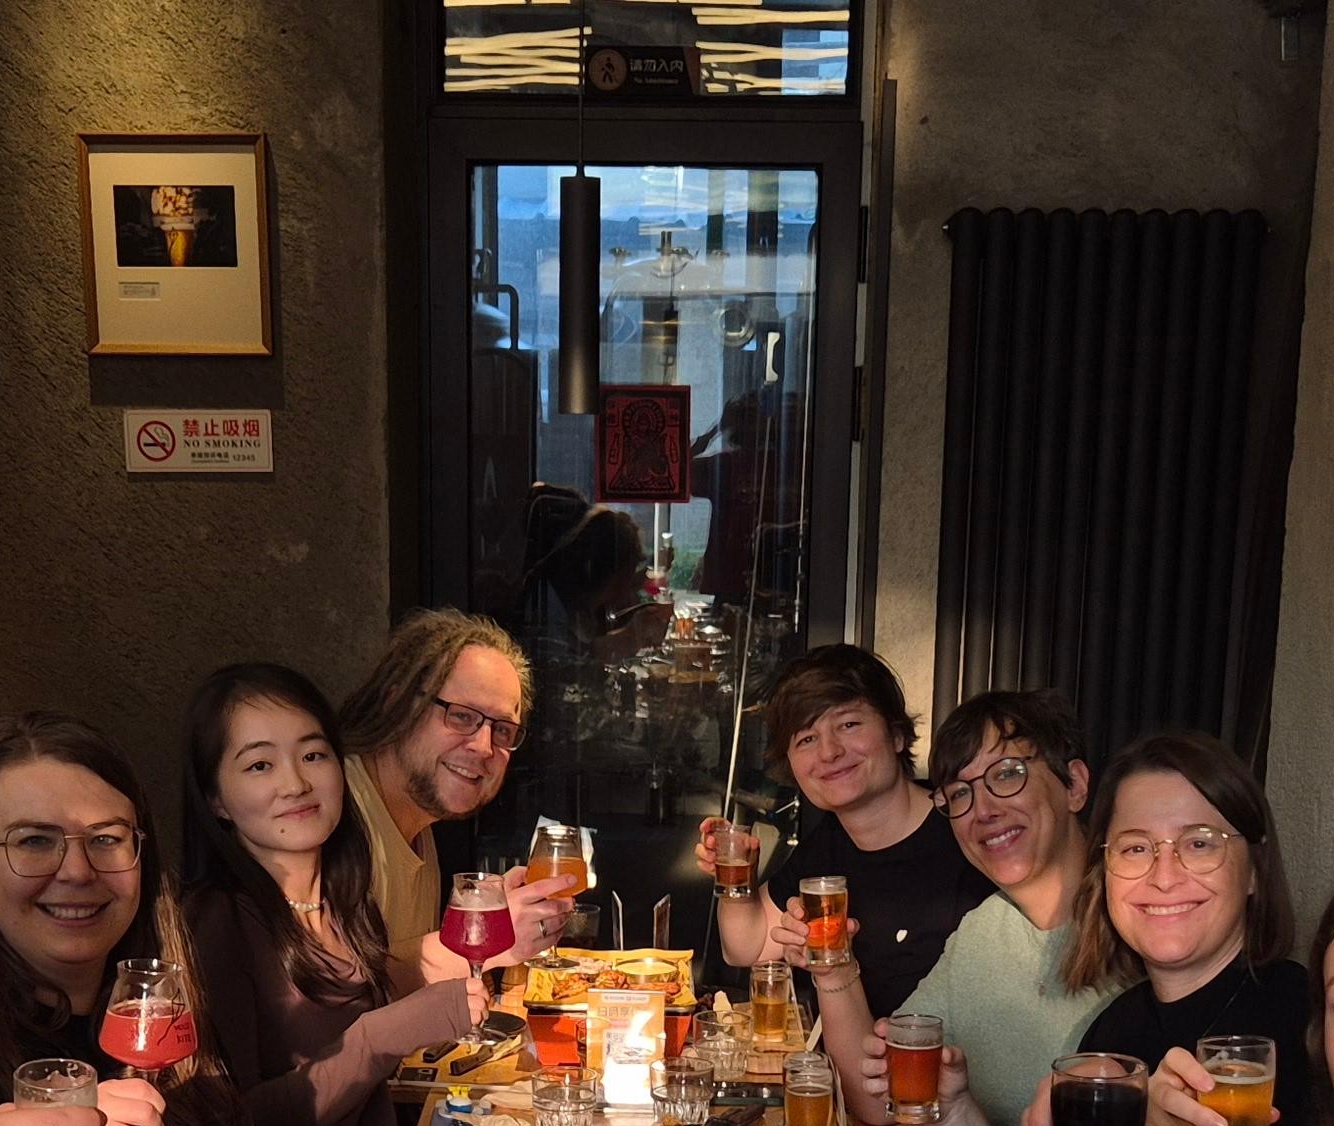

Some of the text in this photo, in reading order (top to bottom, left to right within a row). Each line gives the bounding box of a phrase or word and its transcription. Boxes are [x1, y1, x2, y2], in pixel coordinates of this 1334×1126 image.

[630, 59, 683, 72] 请勿入内
[182, 419, 260, 437] 禁止吸烟
[183, 439, 261, 448] NO SMOKING
